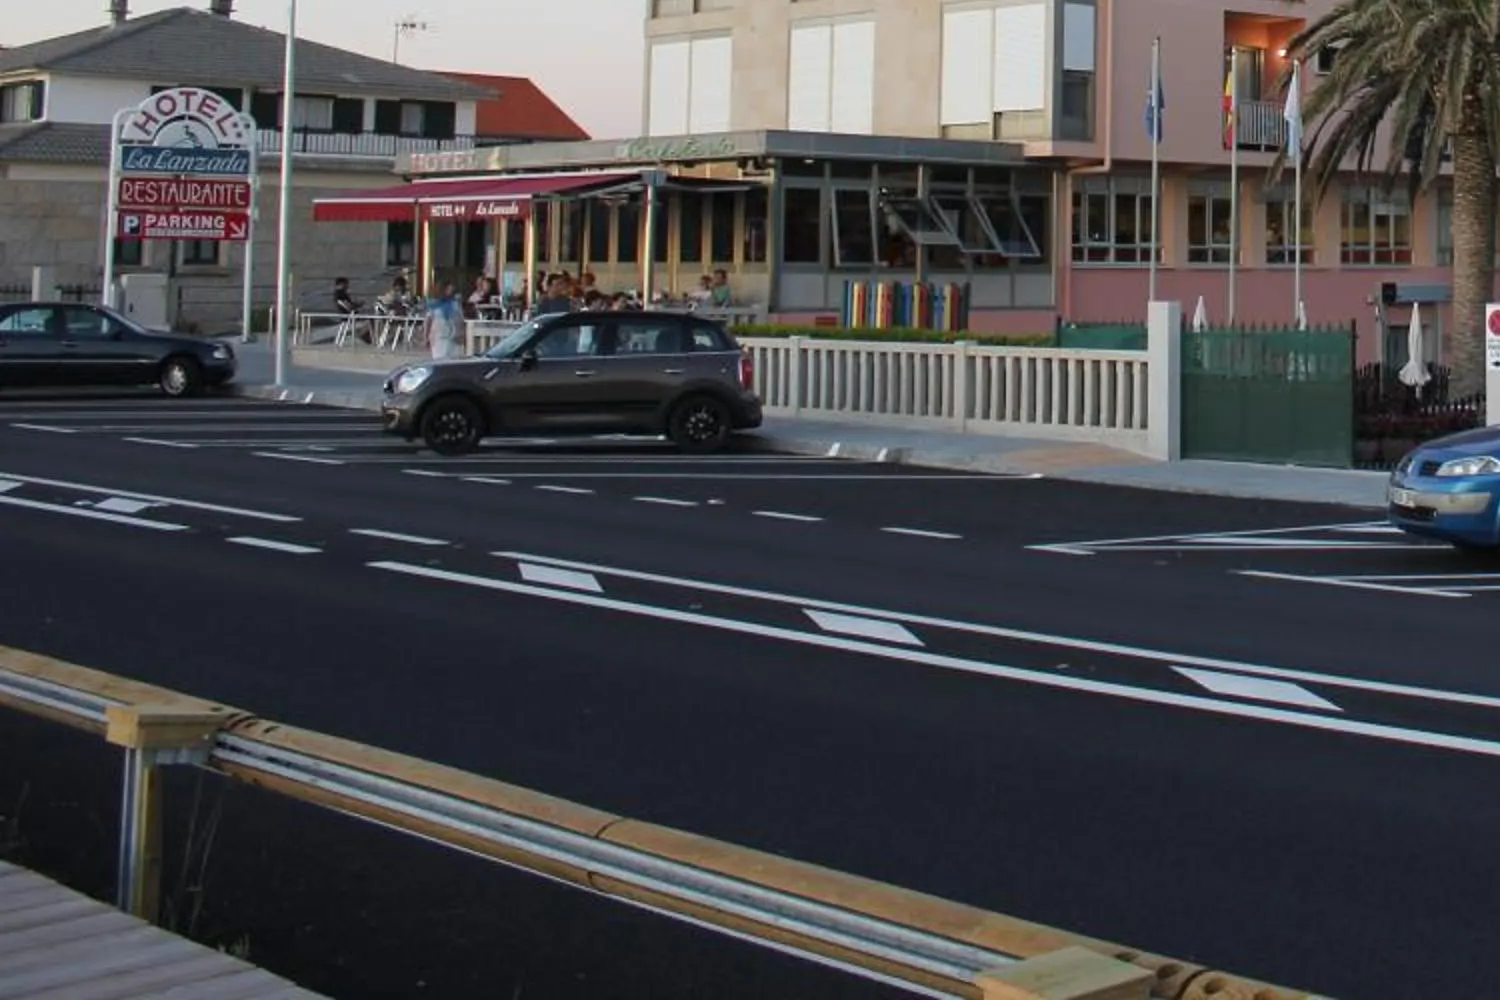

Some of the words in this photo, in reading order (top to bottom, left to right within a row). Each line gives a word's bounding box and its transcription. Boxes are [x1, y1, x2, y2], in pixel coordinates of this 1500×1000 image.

[132, 90, 234, 137] HOTEL
[125, 150, 150, 169] La
[154, 150, 247, 173] Lanzada
[121, 180, 246, 205] RESTAURANTE
[145, 214, 226, 229] PARKING
